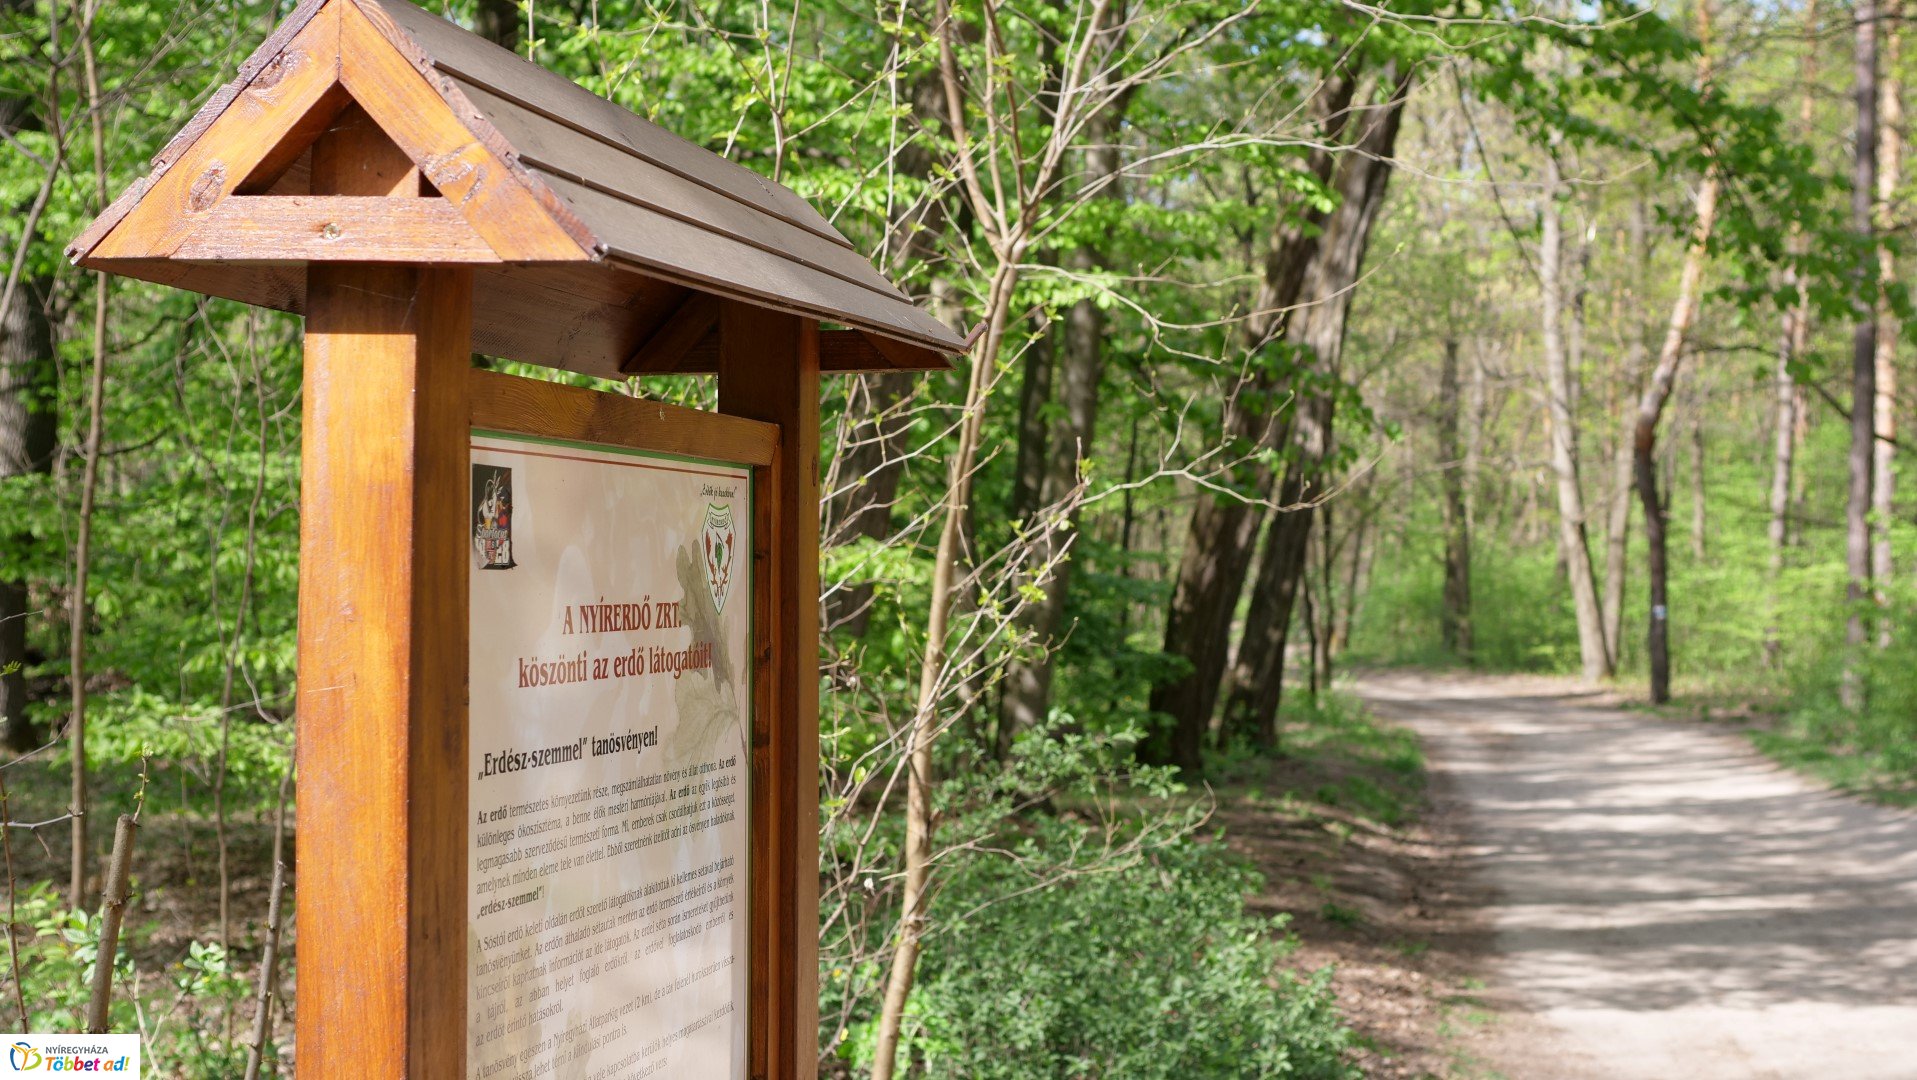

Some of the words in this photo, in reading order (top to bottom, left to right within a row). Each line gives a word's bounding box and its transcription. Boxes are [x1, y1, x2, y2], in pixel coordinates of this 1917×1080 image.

[562, 605, 574, 635] A
[580, 596, 650, 634] NYÍRERDŐ
[656, 602, 682, 629] ZRT.
[518, 650, 588, 688] köszönti
[592, 656, 609, 680] az
[614, 646, 644, 678] erdő
[649, 642, 712, 680] látogatóit!
[592, 726, 658, 757] tanösvényen!
[478, 810, 486, 825] Az
[490, 805, 507, 822] erdő
[510, 798, 548, 818] természetes
[551, 787, 591, 809] környezetünk
[593, 786, 609, 799] része,
[612, 773, 662, 796] megszámlálhatatlan
[682, 767, 687, 778] és
[719, 758, 724, 770] Az
[726, 755, 736, 768] erdő
[478, 829, 514, 848] különleges
[518, 817, 562, 838] ökoszisztéma,
[573, 811, 591, 825] benne
[594, 805, 605, 820] élők
[608, 799, 628, 816] mesteri
[670, 788, 676, 800] Az
[679, 784, 689, 798] erdő
[692, 786, 697, 795] az
[731, 774, 736, 785] és
[477, 846, 522, 873] legmagasabb
[525, 835, 567, 858] szerveződésű
[570, 827, 600, 847] természeti
[632, 812, 654, 830] emberek
[656, 809, 667, 824] csak
[477, 872, 510, 895] amelynek
[513, 867, 537, 885] minden
[540, 862, 558, 877] eleme
[561, 856, 572, 871] tele
[574, 856, 584, 867] van
[586, 846, 605, 864] élettel.
[625, 833, 653, 852] szeretnénk
[683, 826, 688, 836] az
[476, 945, 532, 977] tanösvényünket.
[535, 942, 542, 956] Az
[545, 935, 562, 952] erdőn
[565, 924, 590, 945] áthaladó
[618, 908, 637, 926] mentén
[639, 908, 645, 918] az
[647, 900, 658, 915] erdő
[708, 881, 712, 893] és
[484, 931, 505, 951] Sóstói
[508, 925, 523, 943] erdő
[526, 918, 543, 937] keleti
[545, 912, 567, 930] oldalán
[570, 905, 585, 922] erdőt
[587, 897, 607, 916] szerető
[513, 961, 547, 987] kaphatnak
[549, 947, 584, 973] információt
[586, 948, 592, 959] az
[595, 941, 604, 956] ide
[633, 928, 639, 941] Az
[515, 996, 523, 1008] az
[529, 985, 550, 1003] abban
[556, 972, 574, 992] helyet
[580, 962, 600, 984] foglaló
[635, 950, 640, 960] az
[476, 1035, 484, 1047] az
[486, 1022, 505, 1043] erdőt
[507, 1013, 526, 1034] érintő
[529, 999, 563, 1025] hatásokról.
[520, 1041, 546, 1064] egészen
